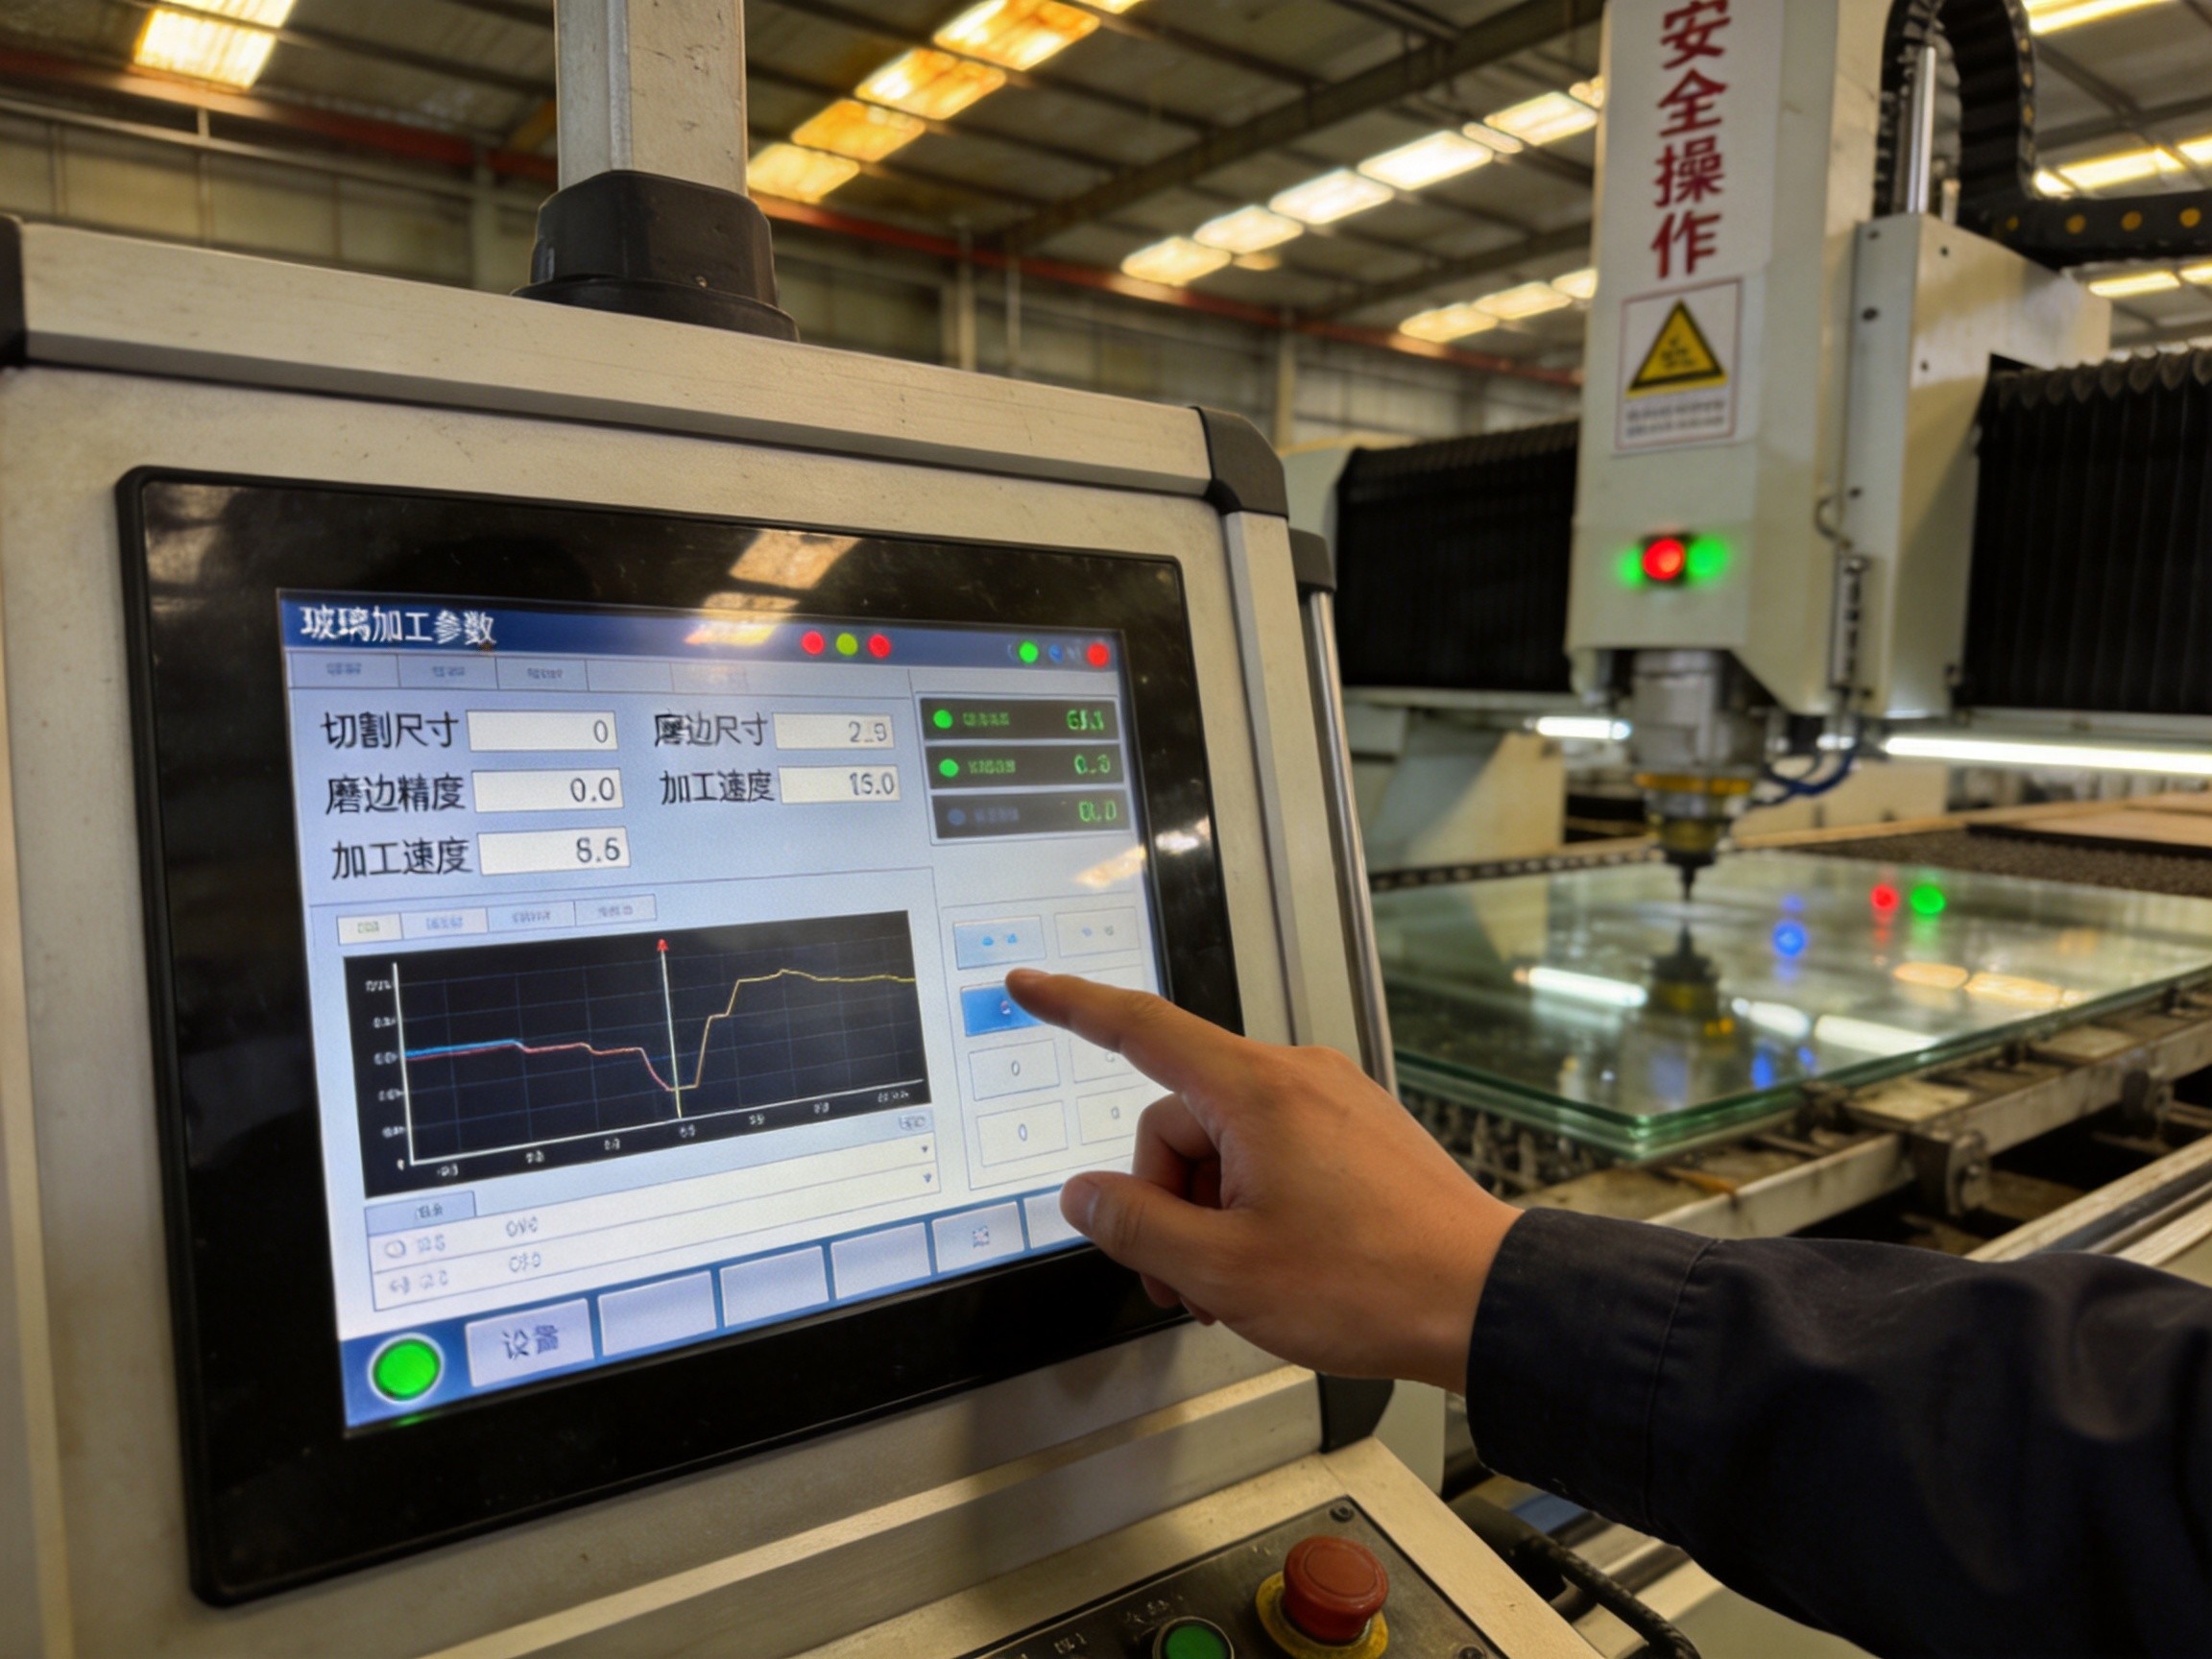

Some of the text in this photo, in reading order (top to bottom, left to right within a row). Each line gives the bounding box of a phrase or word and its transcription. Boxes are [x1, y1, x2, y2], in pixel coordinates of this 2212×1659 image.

[1650, 0, 1731, 279] 安全操作
[300, 604, 497, 645] 玻璃加工参数
[321, 710, 459, 749] 切割尺寸
[592, 719, 609, 744] 0
[325, 774, 467, 815] 磨边精度
[569, 777, 616, 804] 0.0
[659, 769, 777, 805] 加工速度
[331, 837, 475, 880] 加工速度
